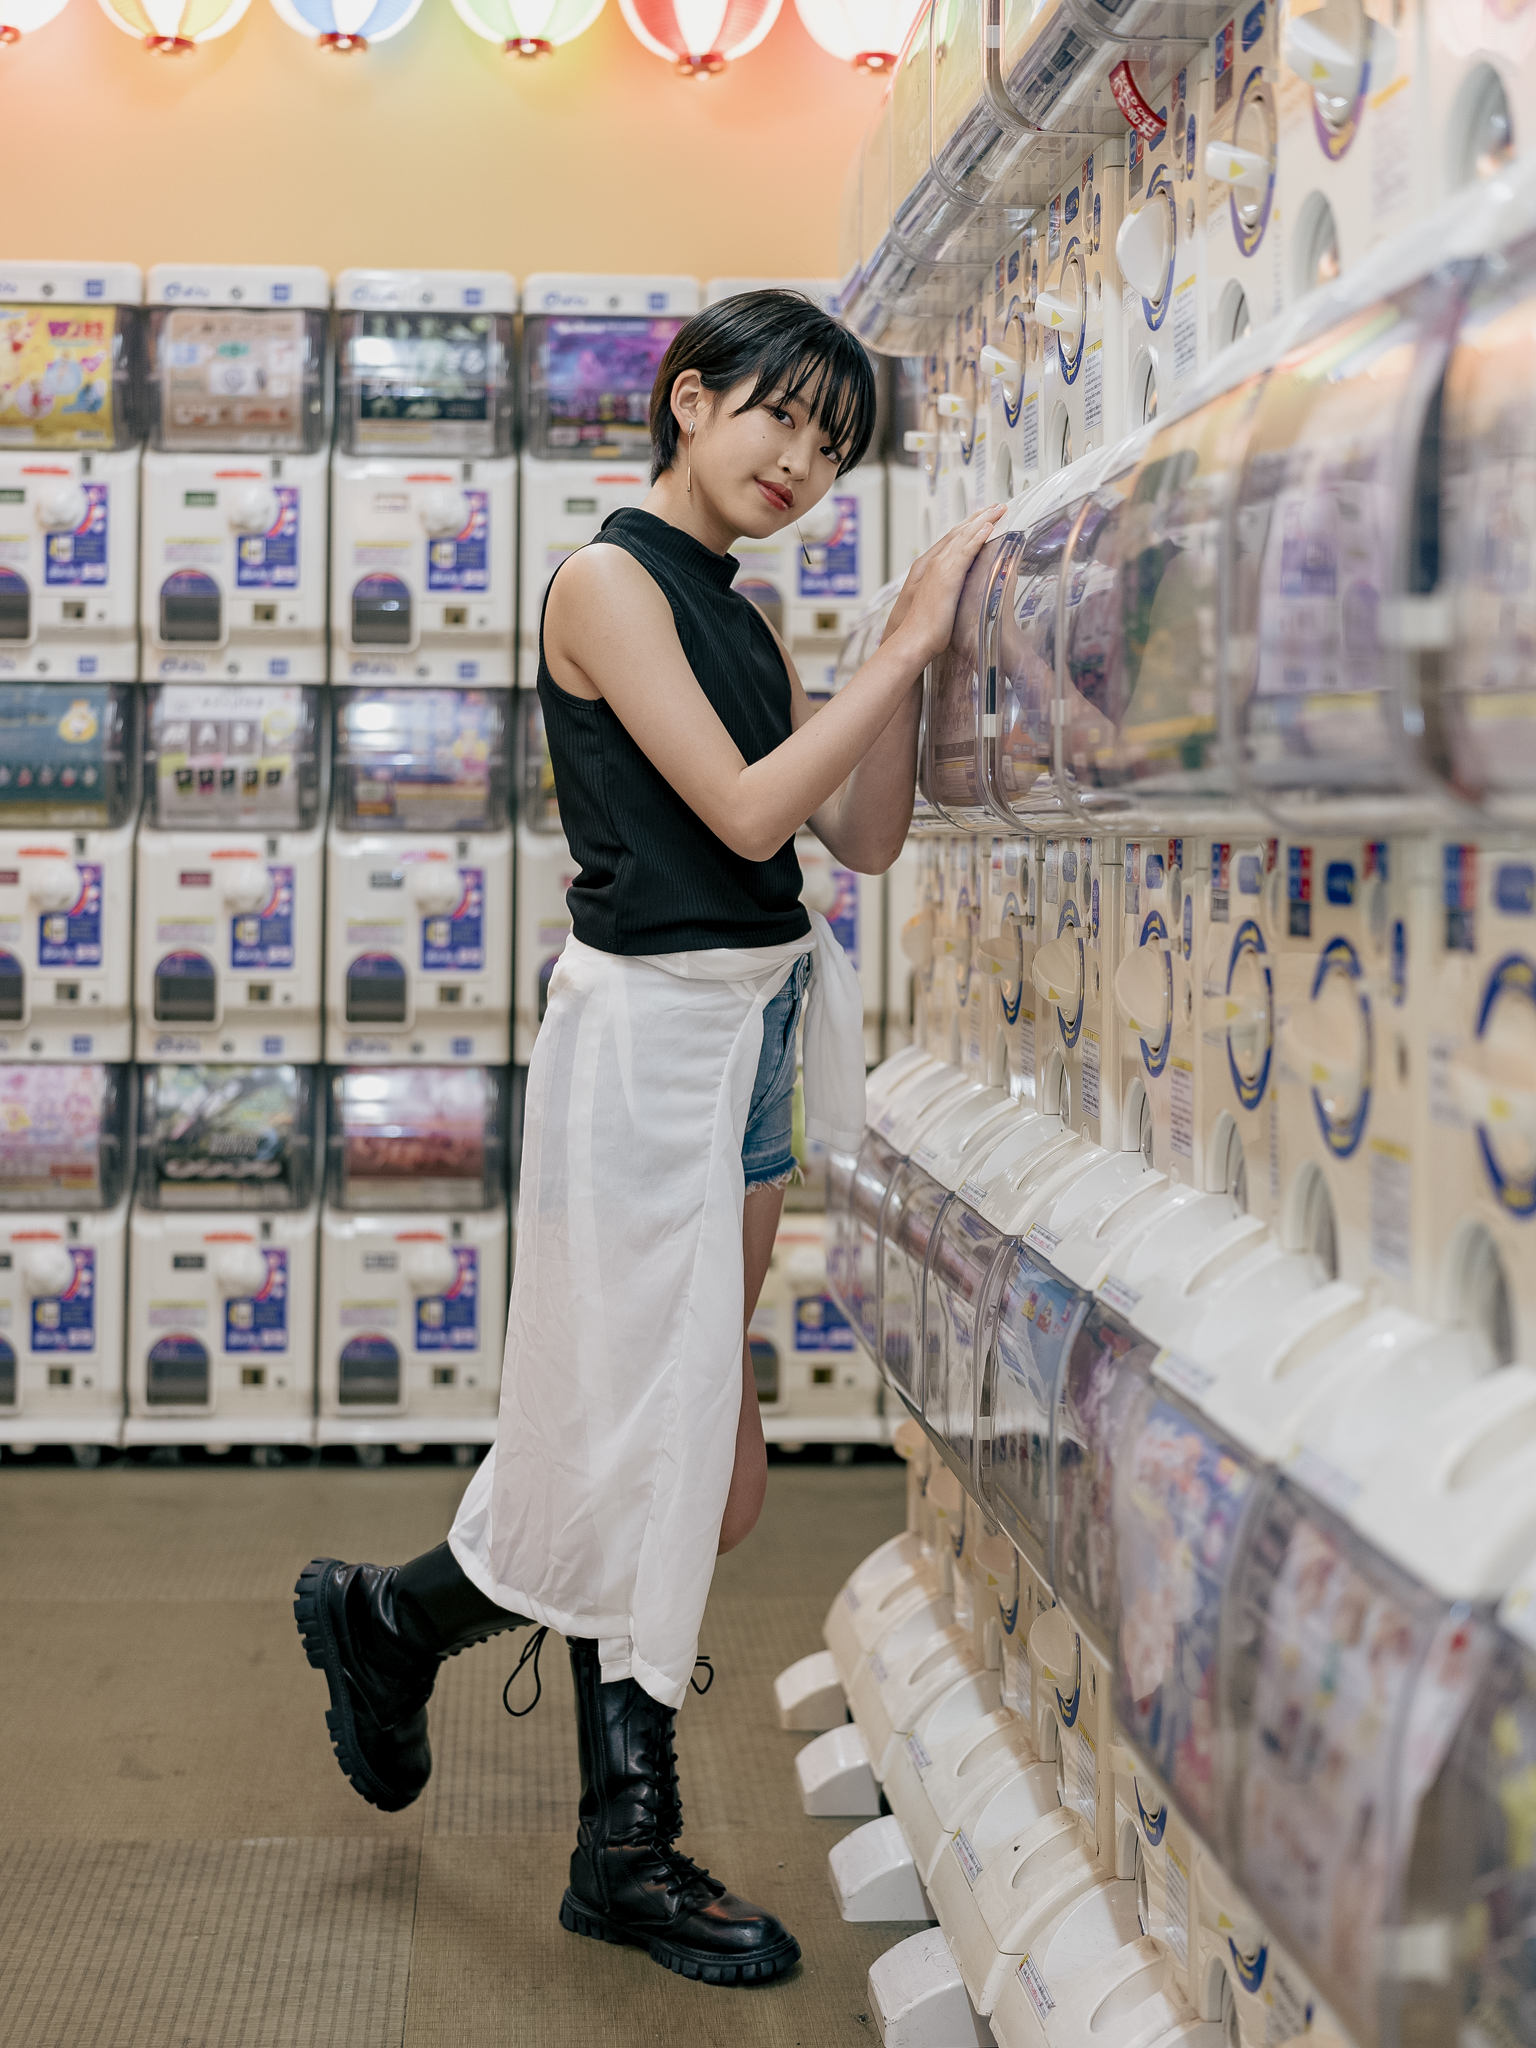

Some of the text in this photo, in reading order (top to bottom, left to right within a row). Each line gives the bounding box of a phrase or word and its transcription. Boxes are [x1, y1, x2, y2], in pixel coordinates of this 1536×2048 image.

[1113, 77, 1155, 137] うりきれ
[1120, 70, 1138, 106] SOLD
[1137, 106, 1160, 129] OUT
